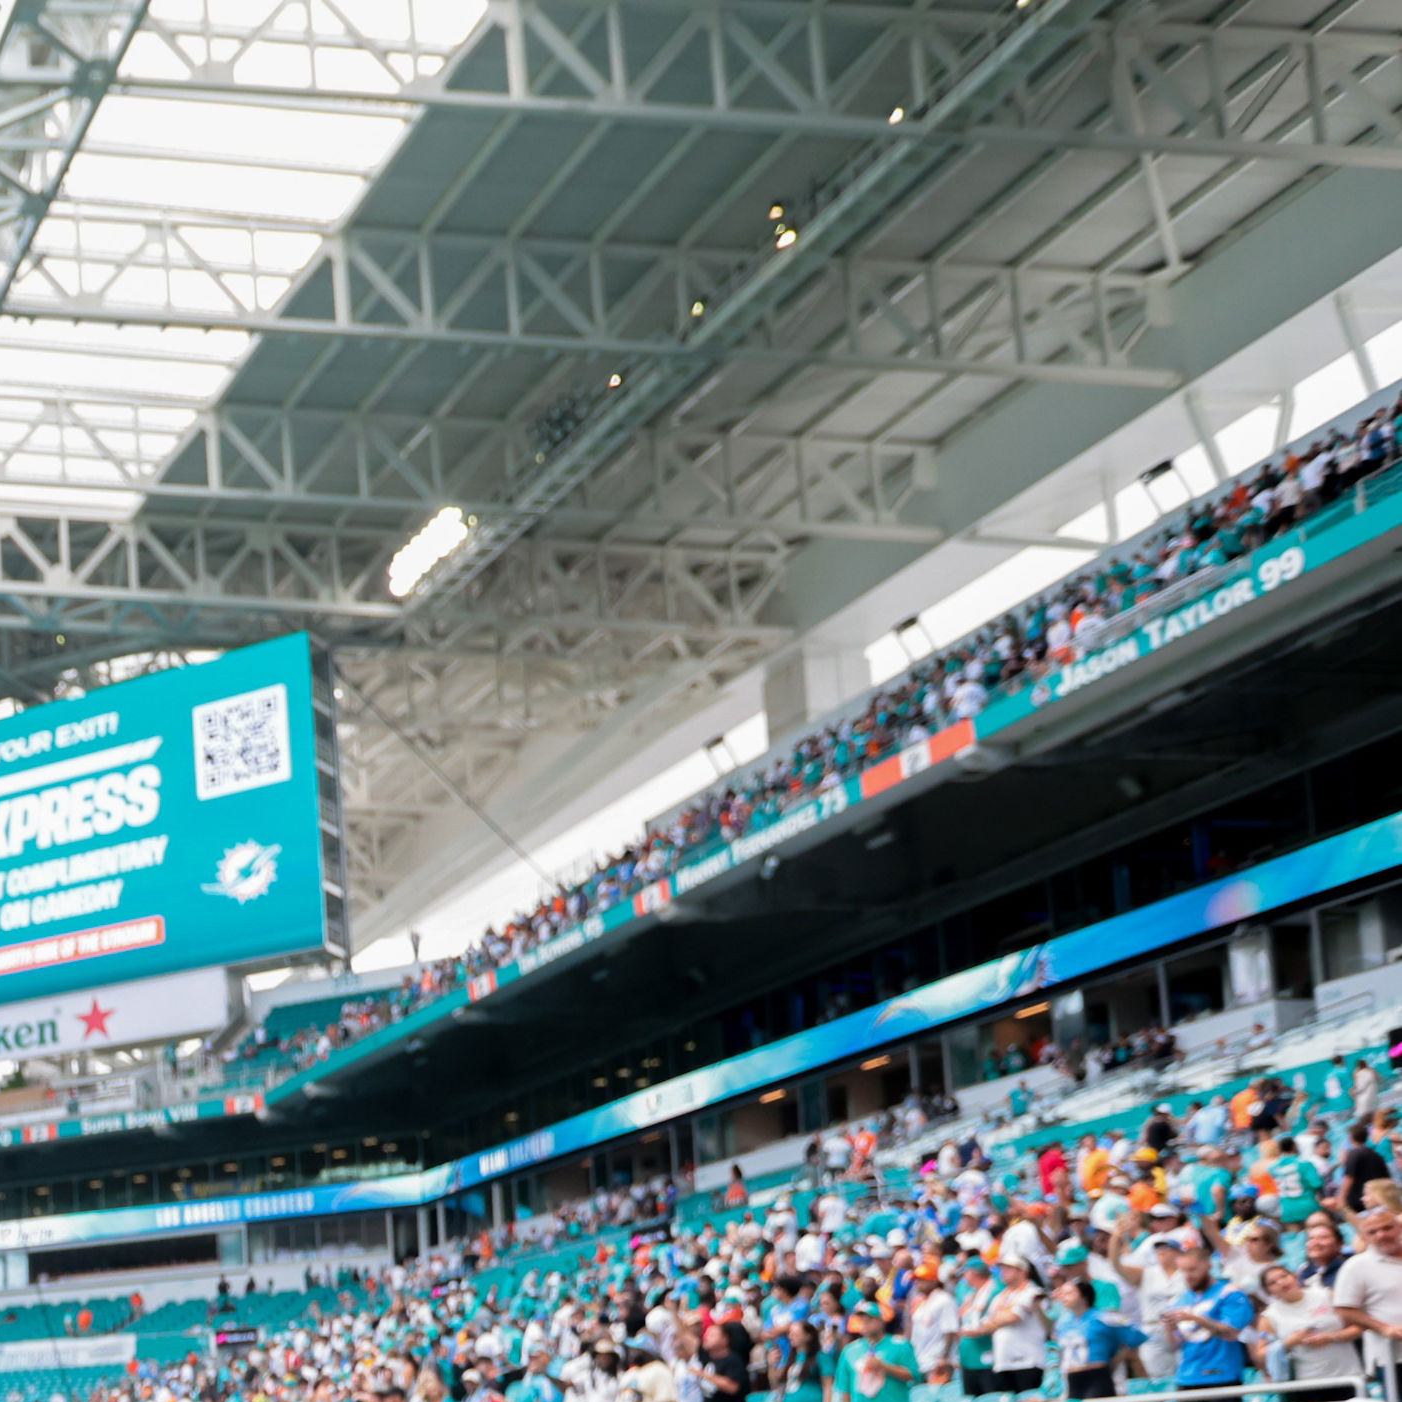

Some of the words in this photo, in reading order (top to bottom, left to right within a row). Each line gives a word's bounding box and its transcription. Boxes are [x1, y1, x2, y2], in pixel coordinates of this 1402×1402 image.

[1054, 636, 1141, 697] JASON
[1142, 576, 1256, 651] TAYLOR
[1257, 547, 1306, 592] 99
[55, 711, 120, 748] EXIT!
[125, 1108, 168, 1131] BOWL
